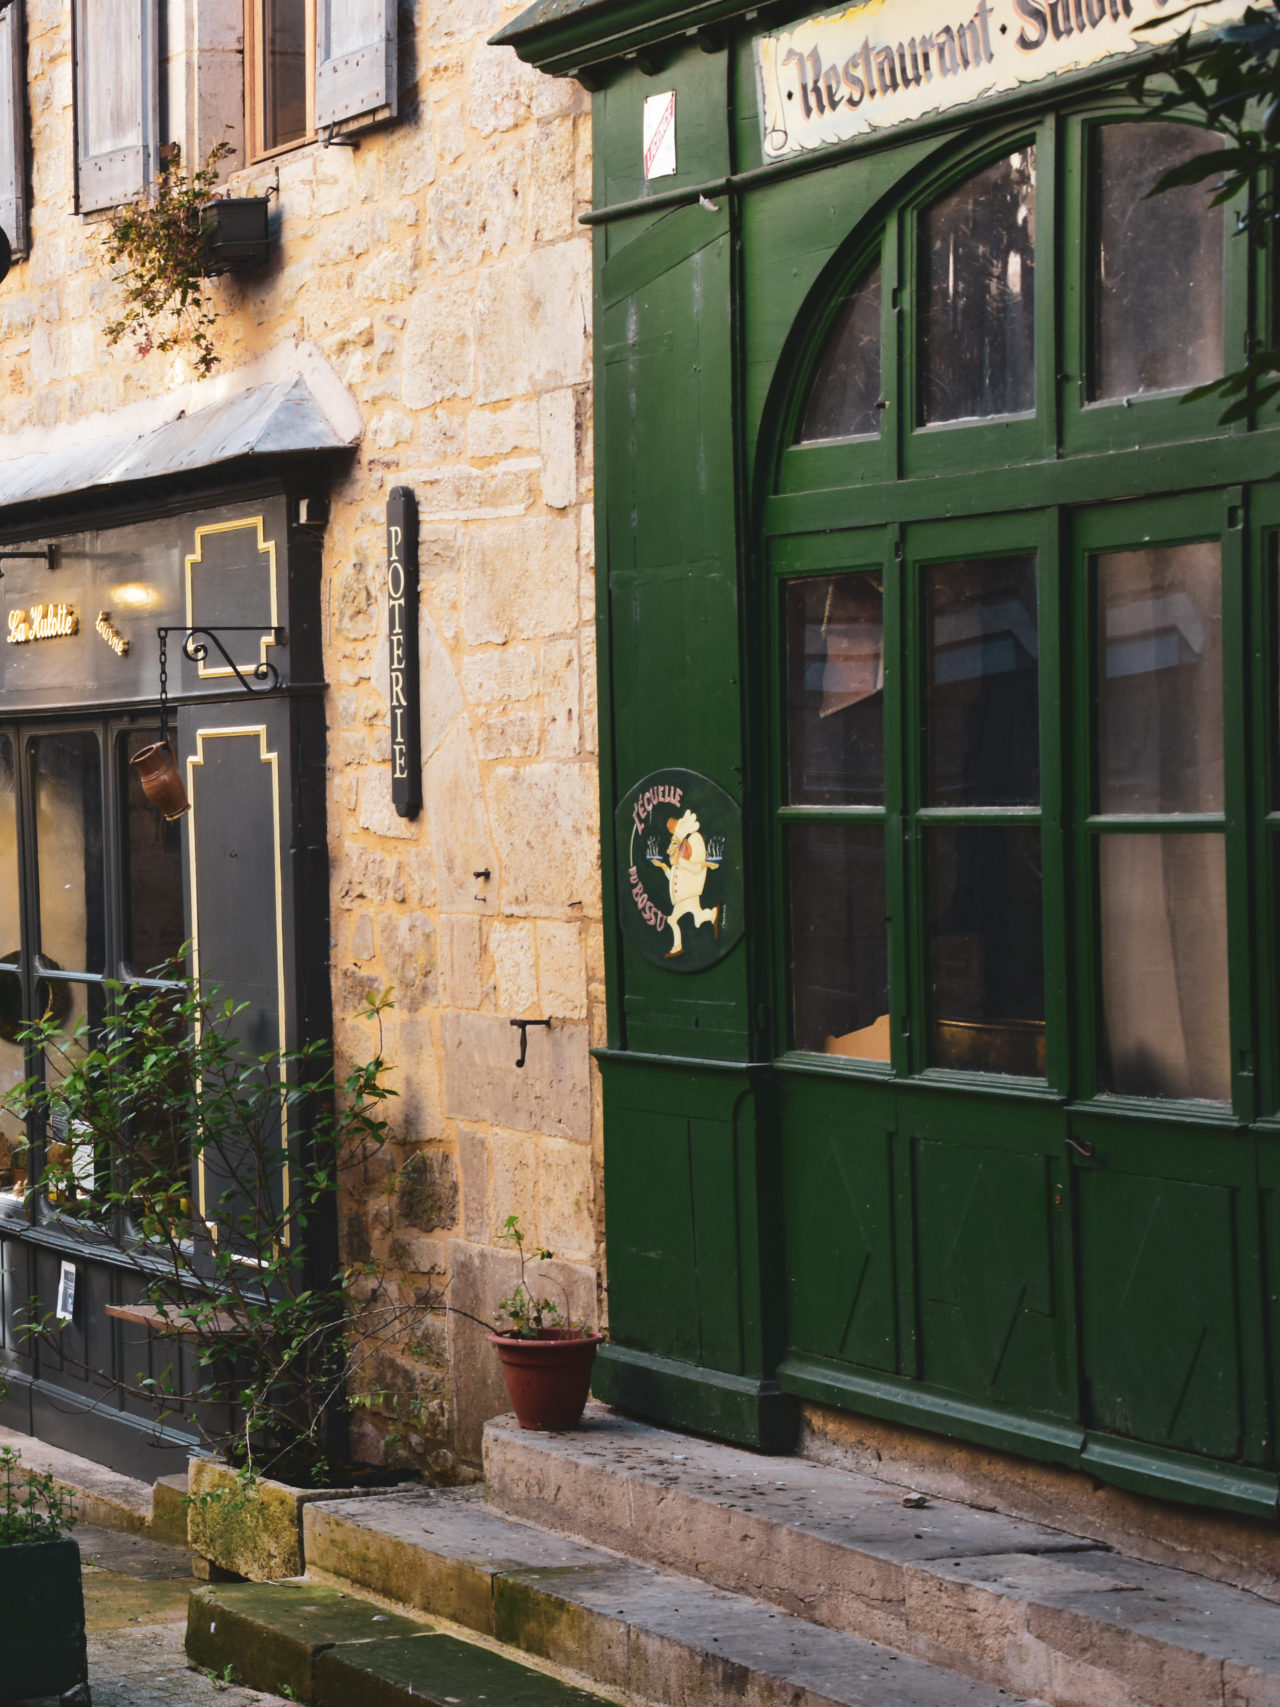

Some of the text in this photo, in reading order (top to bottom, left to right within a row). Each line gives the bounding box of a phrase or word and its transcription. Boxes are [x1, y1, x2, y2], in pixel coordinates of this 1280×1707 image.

[782, 4, 995, 119] Restaurant
[6, 609, 27, 643] La
[388, 525, 408, 779] POTERIE
[631, 881, 668, 932] BOSSU
